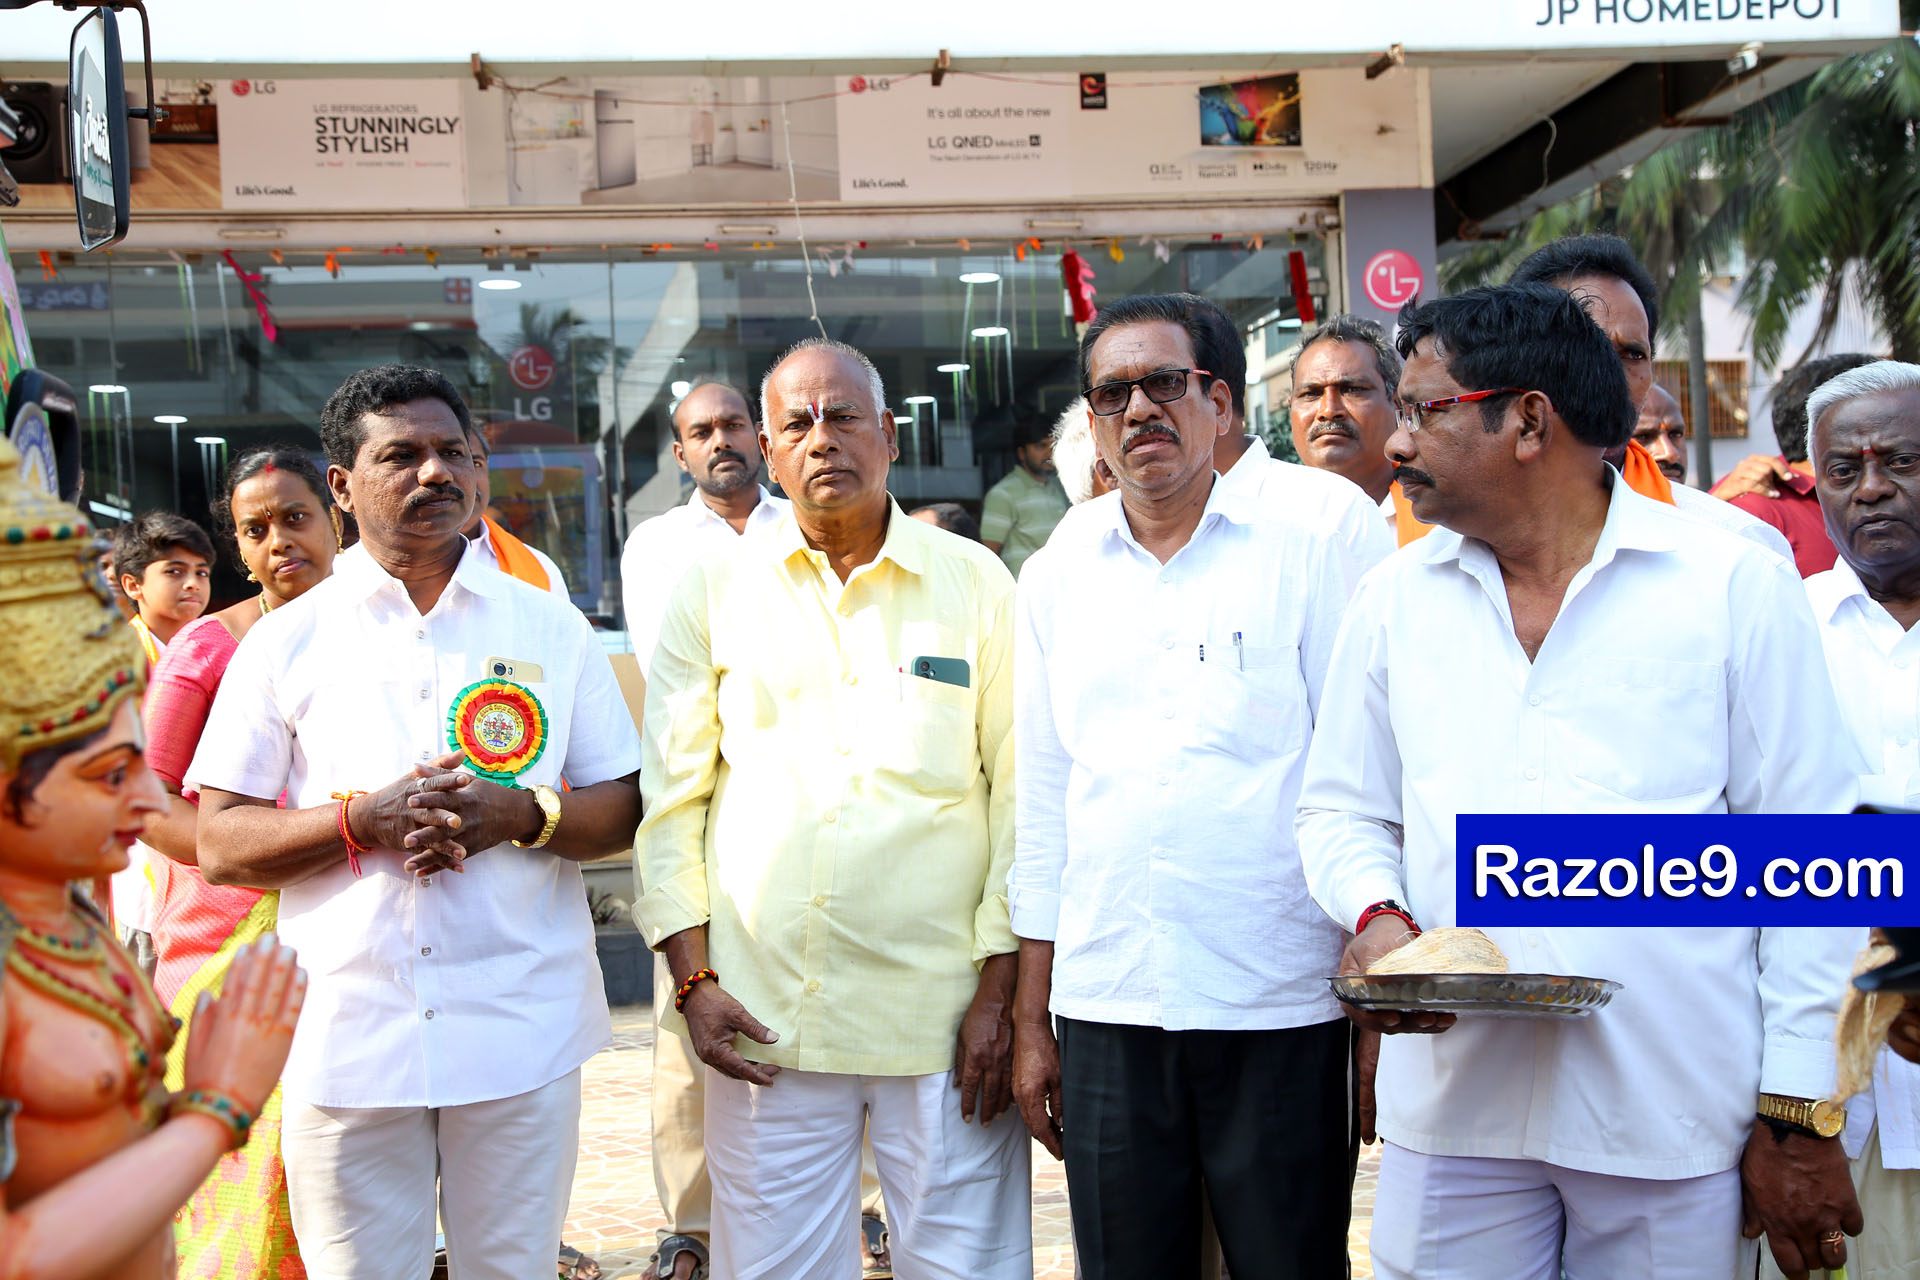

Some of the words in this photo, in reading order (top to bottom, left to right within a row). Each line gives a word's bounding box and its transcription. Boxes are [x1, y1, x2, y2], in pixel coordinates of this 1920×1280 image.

[1536, 0, 1579, 26] JP
[254, 80, 276, 94] LG
[869, 79, 890, 91] LG
[313, 104, 327, 114] LG
[330, 103, 419, 114] REFRIGERATORS
[927, 107, 945, 119] It's
[947, 107, 963, 119] all
[964, 107, 1001, 119] about
[1003, 106, 1024, 118] the
[1026, 107, 1052, 117] new
[315, 116, 460, 135] STUNNINGLY
[316, 135, 409, 154] STYLISH
[928, 136, 947, 149] LG
[952, 135, 993, 149] QNED
[235, 184, 262, 196] Life's
[263, 184, 297, 197] Good.
[852, 178, 877, 189] Life's
[878, 178, 909, 189] Good.
[514, 396, 553, 421] LG
